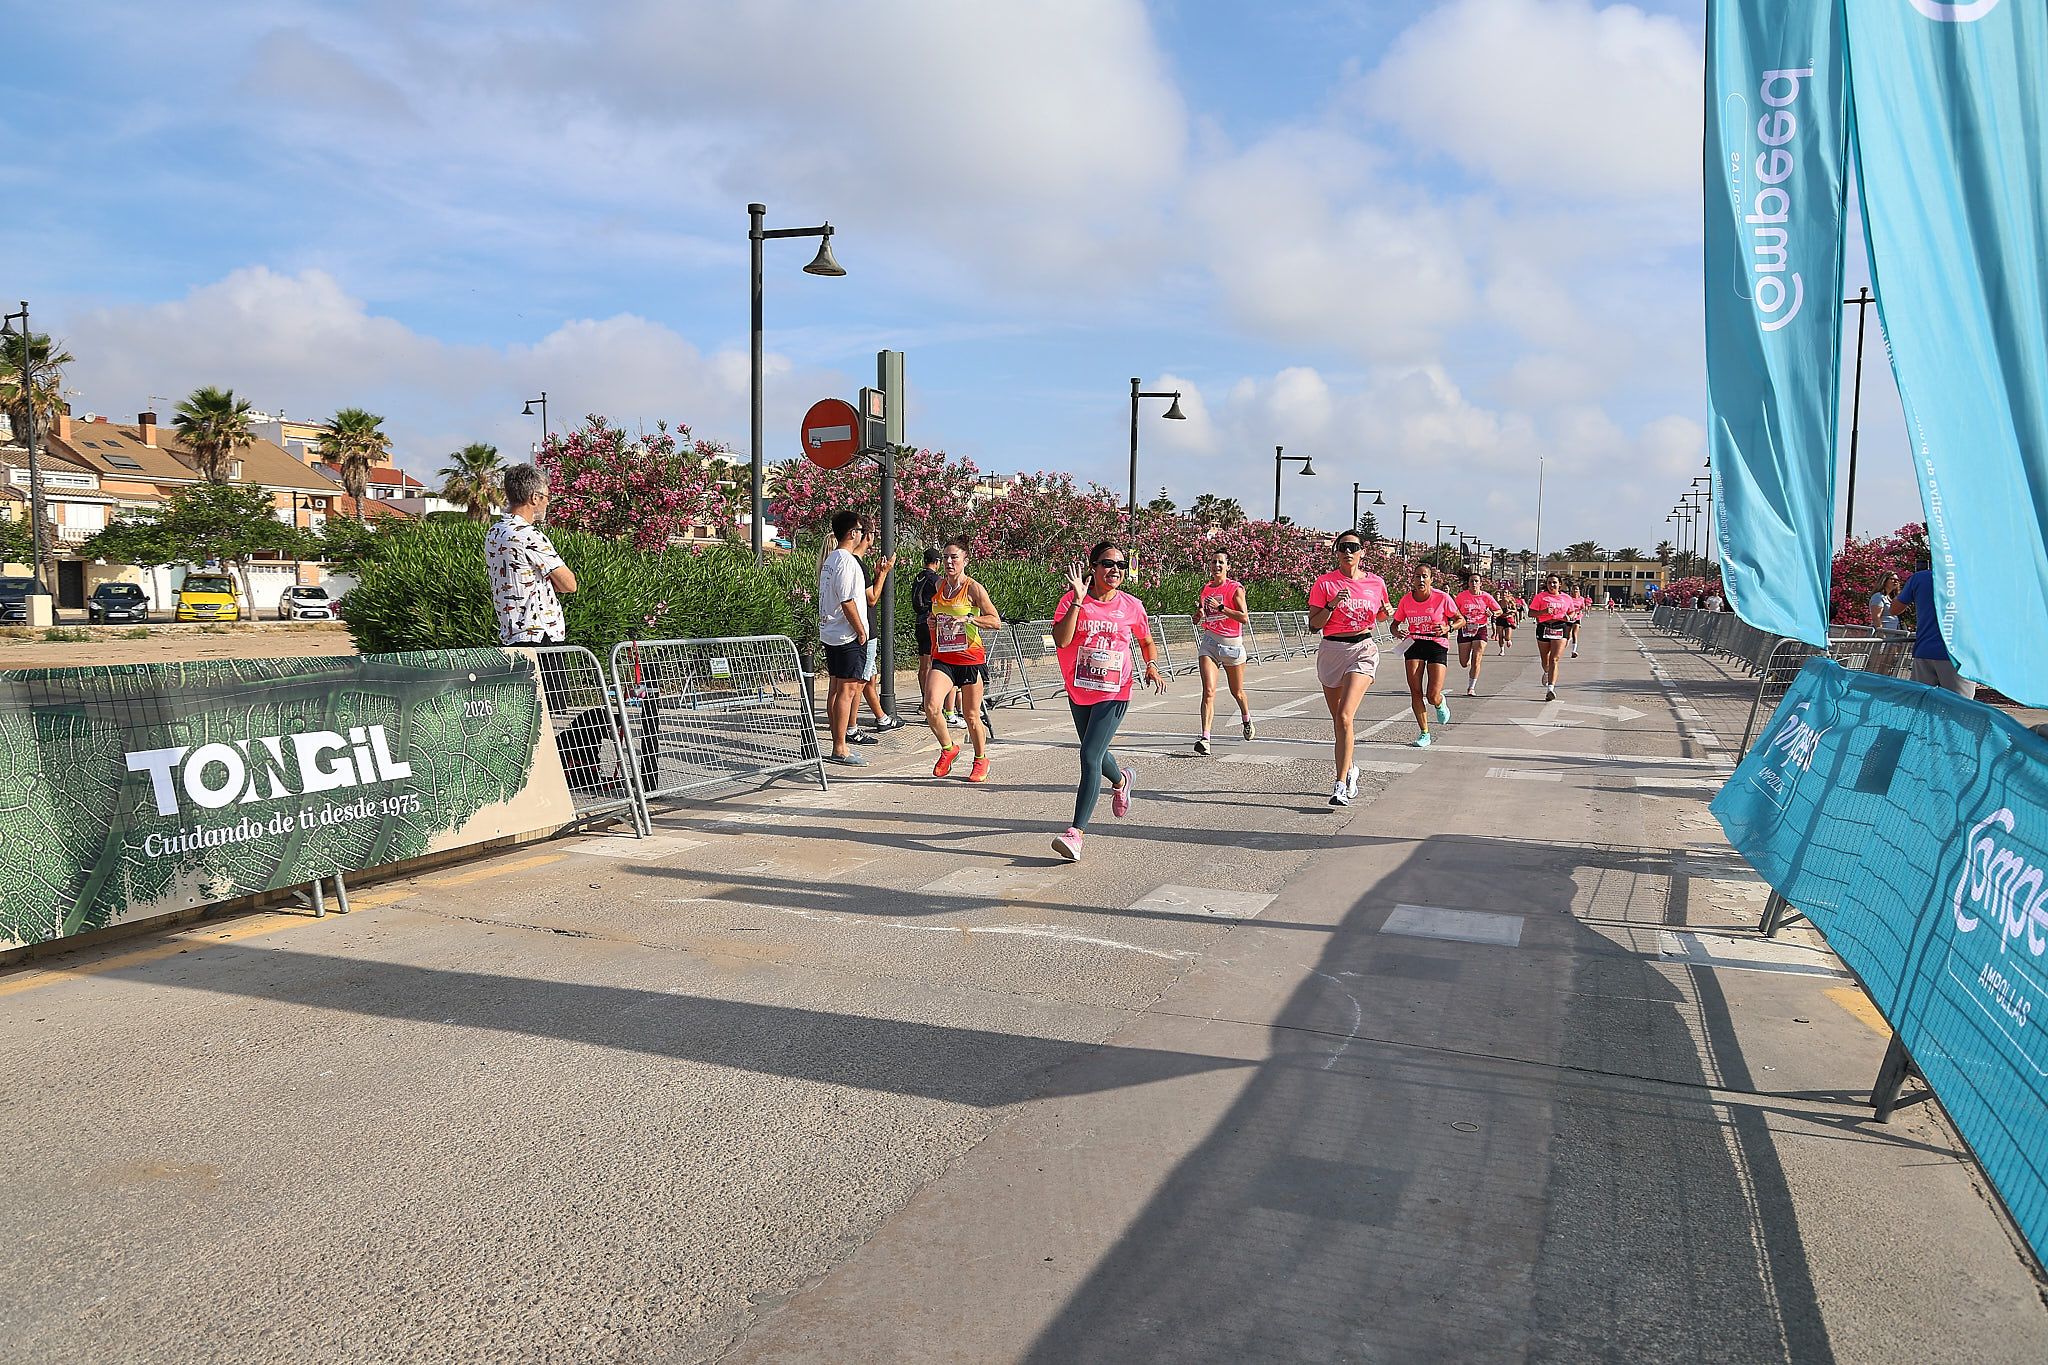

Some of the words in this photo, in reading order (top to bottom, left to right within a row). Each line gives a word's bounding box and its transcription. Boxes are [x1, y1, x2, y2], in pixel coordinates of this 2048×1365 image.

[1077, 620, 1119, 634] CARRERA
[464, 700, 493, 718] 2026
[144, 818, 264, 858] Cuidando
[268, 811, 295, 835] de
[299, 806, 316, 830] ti
[320, 797, 377, 826] desde
[381, 793, 421, 818] 1975
[1977, 962, 2032, 1028] AMPOLLAS
